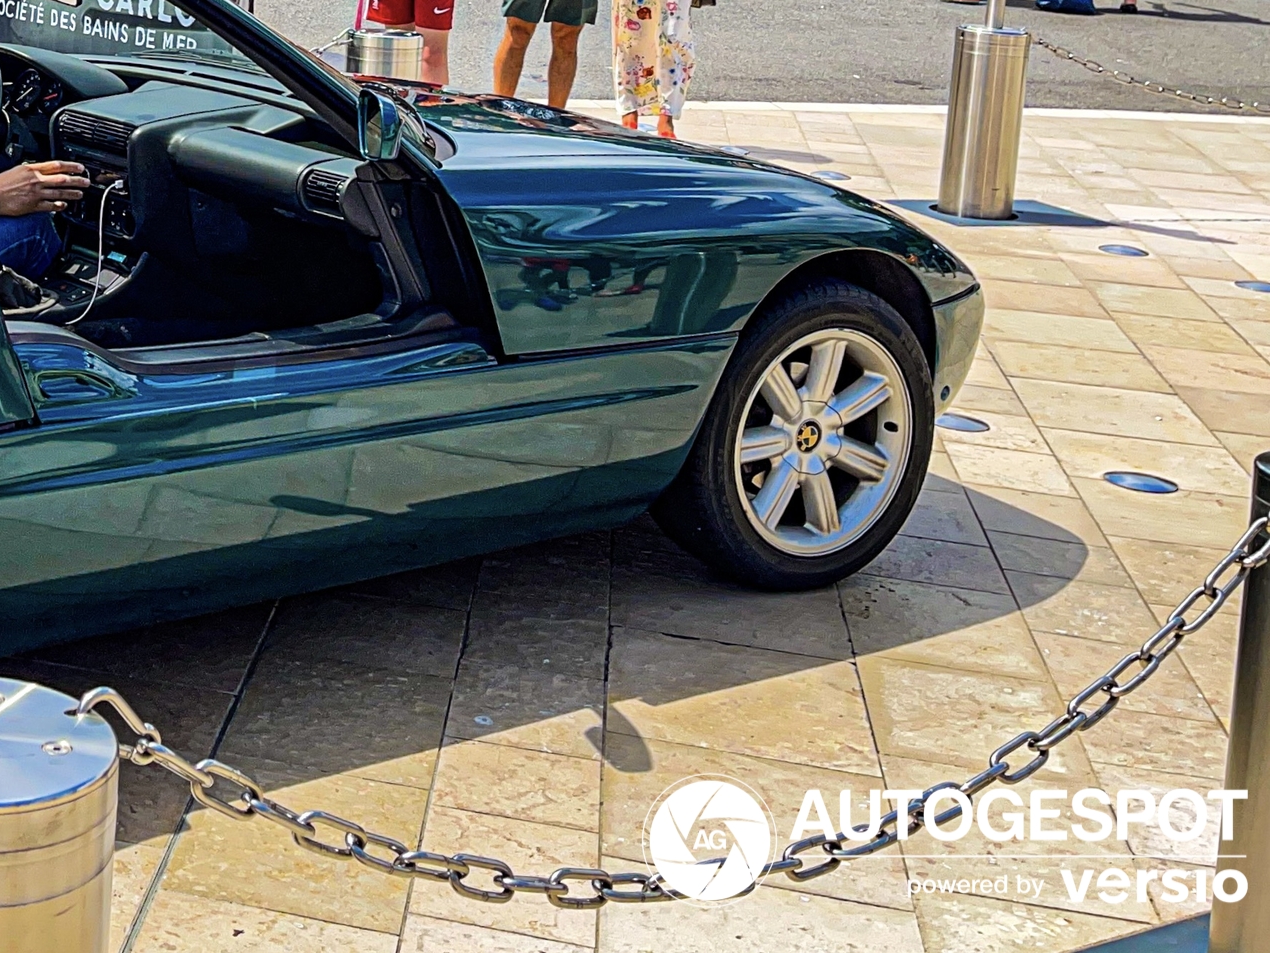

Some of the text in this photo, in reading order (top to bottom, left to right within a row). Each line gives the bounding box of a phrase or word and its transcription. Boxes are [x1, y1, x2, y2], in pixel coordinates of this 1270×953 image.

[50, 8, 77, 32] DES
[83, 15, 129, 44] BAINS
[135, 26, 157, 49] DE
[162, 31, 197, 50] MER
